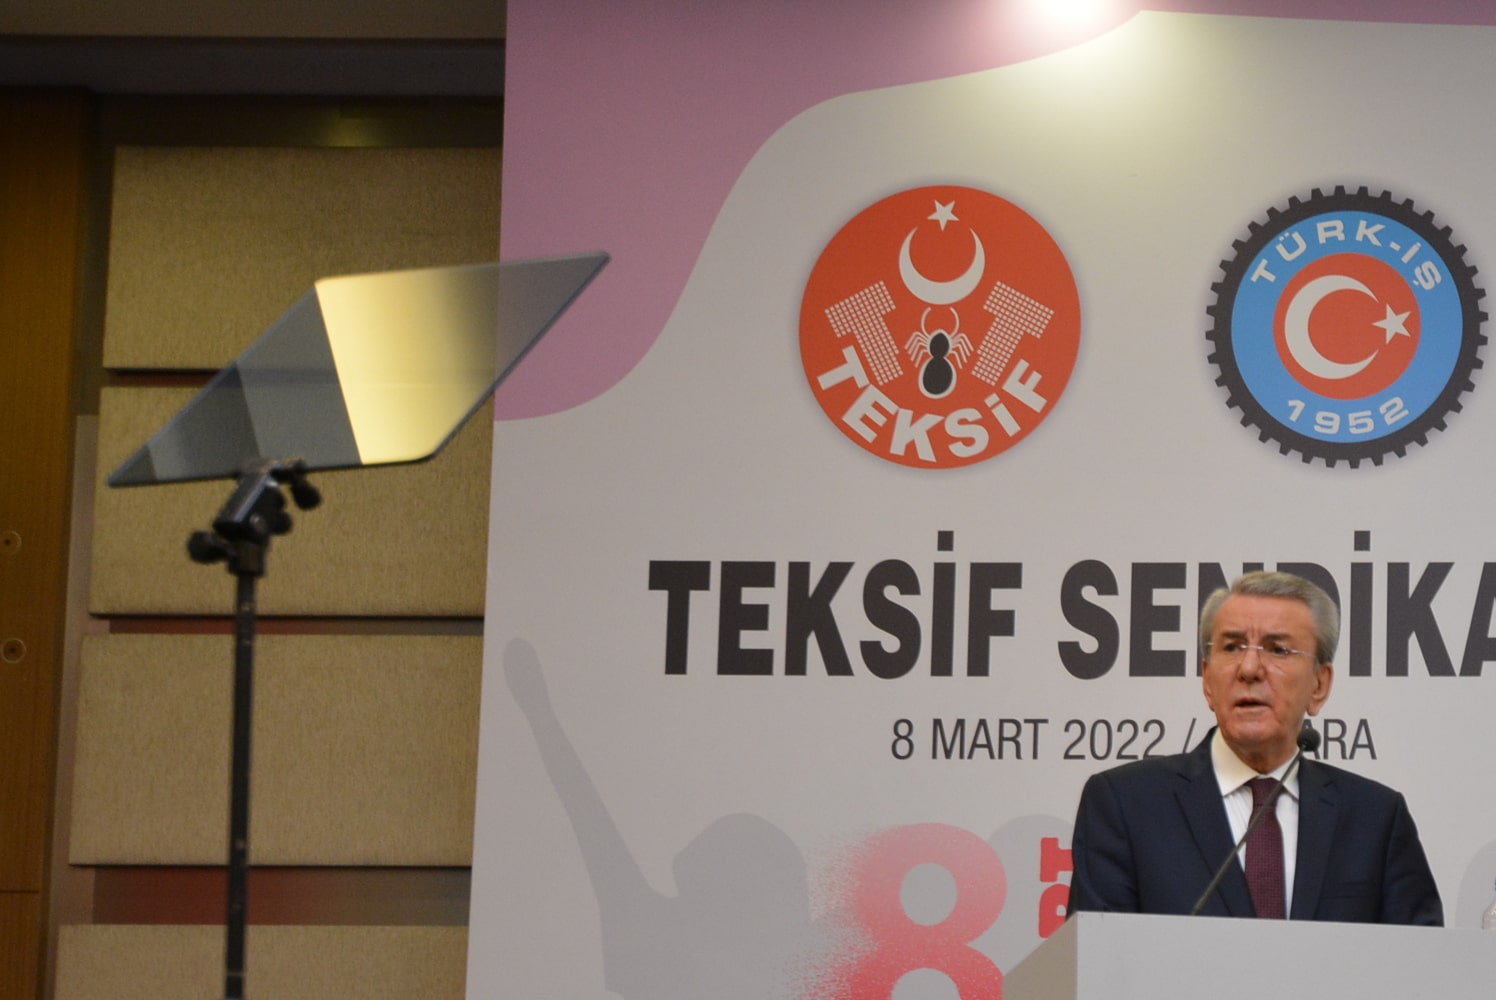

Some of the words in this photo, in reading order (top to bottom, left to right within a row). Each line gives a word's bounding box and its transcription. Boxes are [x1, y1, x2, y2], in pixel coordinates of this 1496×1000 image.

[1286, 396, 1410, 435] 1952
[648, 530, 1023, 680] TEKSİF
[890, 717, 915, 760] 8
[930, 718, 1049, 760] MART
[1062, 717, 1166, 760] 2022
